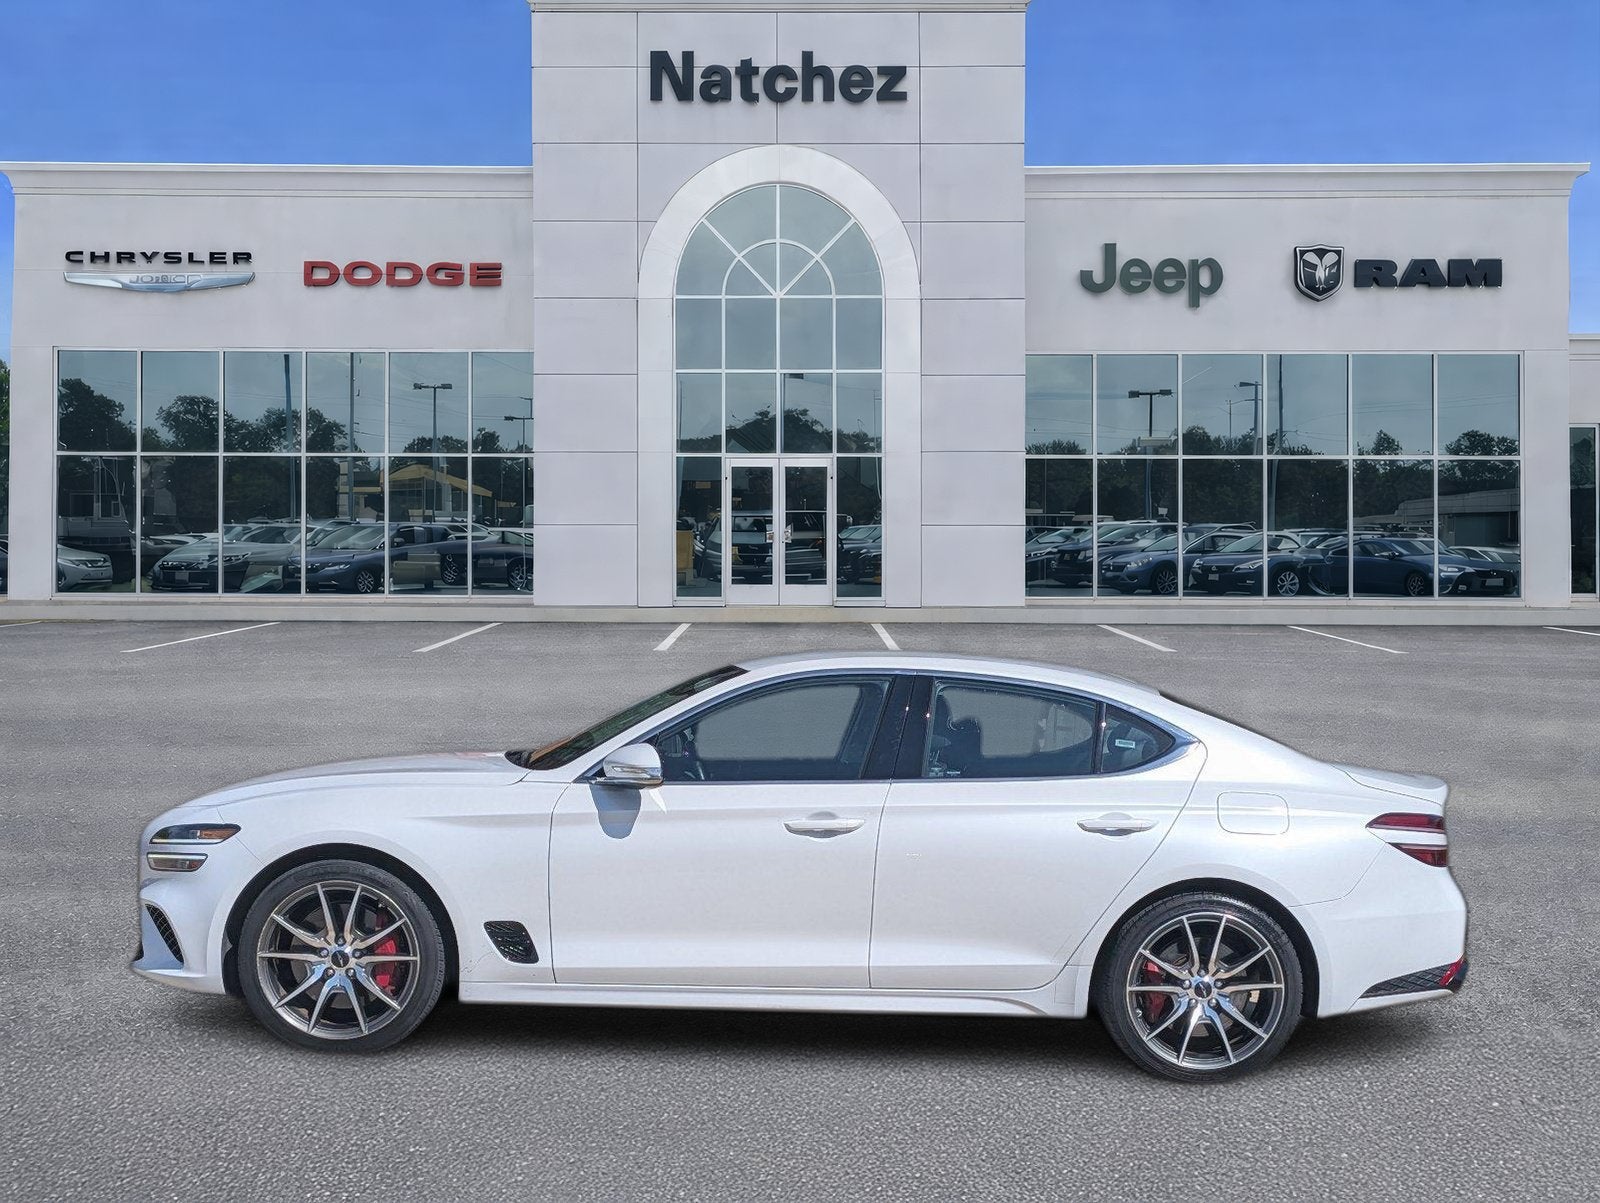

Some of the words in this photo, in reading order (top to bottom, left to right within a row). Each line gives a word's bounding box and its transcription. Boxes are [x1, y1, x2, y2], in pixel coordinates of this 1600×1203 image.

[650, 50, 908, 103] Natchez
[65, 250, 252, 264] CHRYSLER
[304, 261, 502, 287] DODGE
[1080, 243, 1224, 308] Jeep
[1354, 259, 1503, 288] RAM
